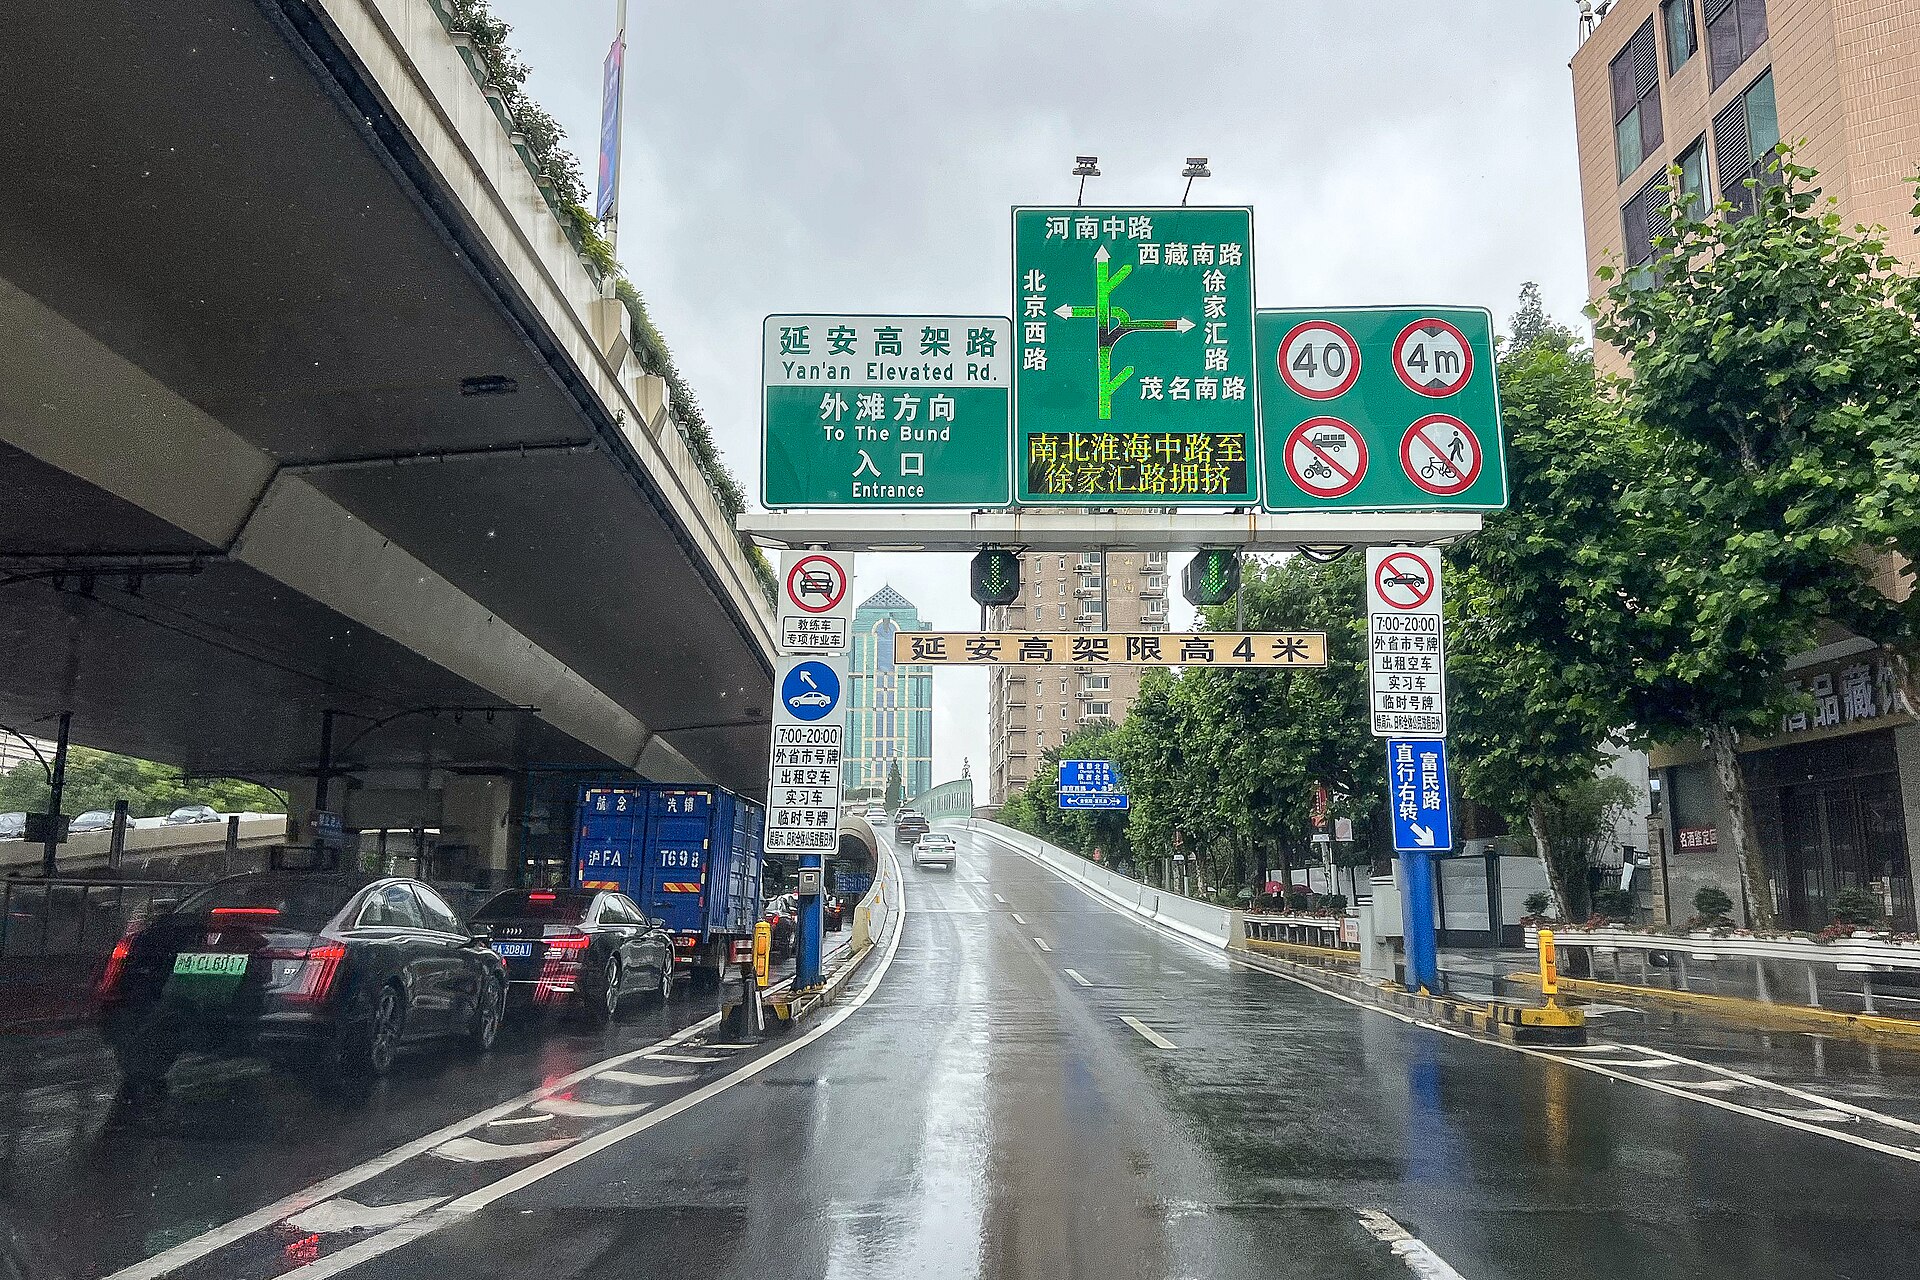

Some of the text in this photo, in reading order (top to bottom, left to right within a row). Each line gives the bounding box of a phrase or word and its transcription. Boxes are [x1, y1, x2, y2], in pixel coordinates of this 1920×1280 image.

[1045, 215, 1154, 241] 河南中路
[1137, 242, 1243, 266] 西藏南路
[1023, 269, 1048, 371] 北京西路
[1202, 269, 1229, 372] 徐家汇路
[779, 324, 998, 358] 延安高架路
[1292, 342, 1346, 378] 40
[1406, 343, 1460, 374] 4m
[782, 361, 998, 381] Yan'an Elevated Rd.
[1139, 376, 1247, 401] 茂名南路
[819, 392, 956, 422] 外滩方向
[823, 425, 951, 441] To The Bund
[1030, 432, 1246, 464] 南北淮海中路至
[852, 449, 925, 478] 入口
[1044, 462, 1231, 494] 徐家汇路拥挤
[852, 481, 925, 498] Entrance
[797, 618, 832, 631] 教练车
[1375, 616, 1435, 632] 7:00-20:00
[787, 633, 841, 646] 专项作业车
[910, 635, 1310, 663] 延安高架限高4米
[1374, 635, 1438, 652] 外省市号牌
[1382, 655, 1432, 672] 出租空车
[1388, 674, 1427, 691] 实习车
[1382, 694, 1434, 711] 临时号牌
[779, 728, 838, 744] 7:00-20:00
[775, 748, 839, 765] 外省市号牌
[780, 768, 831, 785] 出租空车
[1395, 743, 1418, 822] 直行右转
[1419, 751, 1441, 811] 富民路
[785, 788, 823, 806] 实习车
[777, 809, 829, 827] 临时号牌
[588, 849, 700, 868] 沪FA T698
